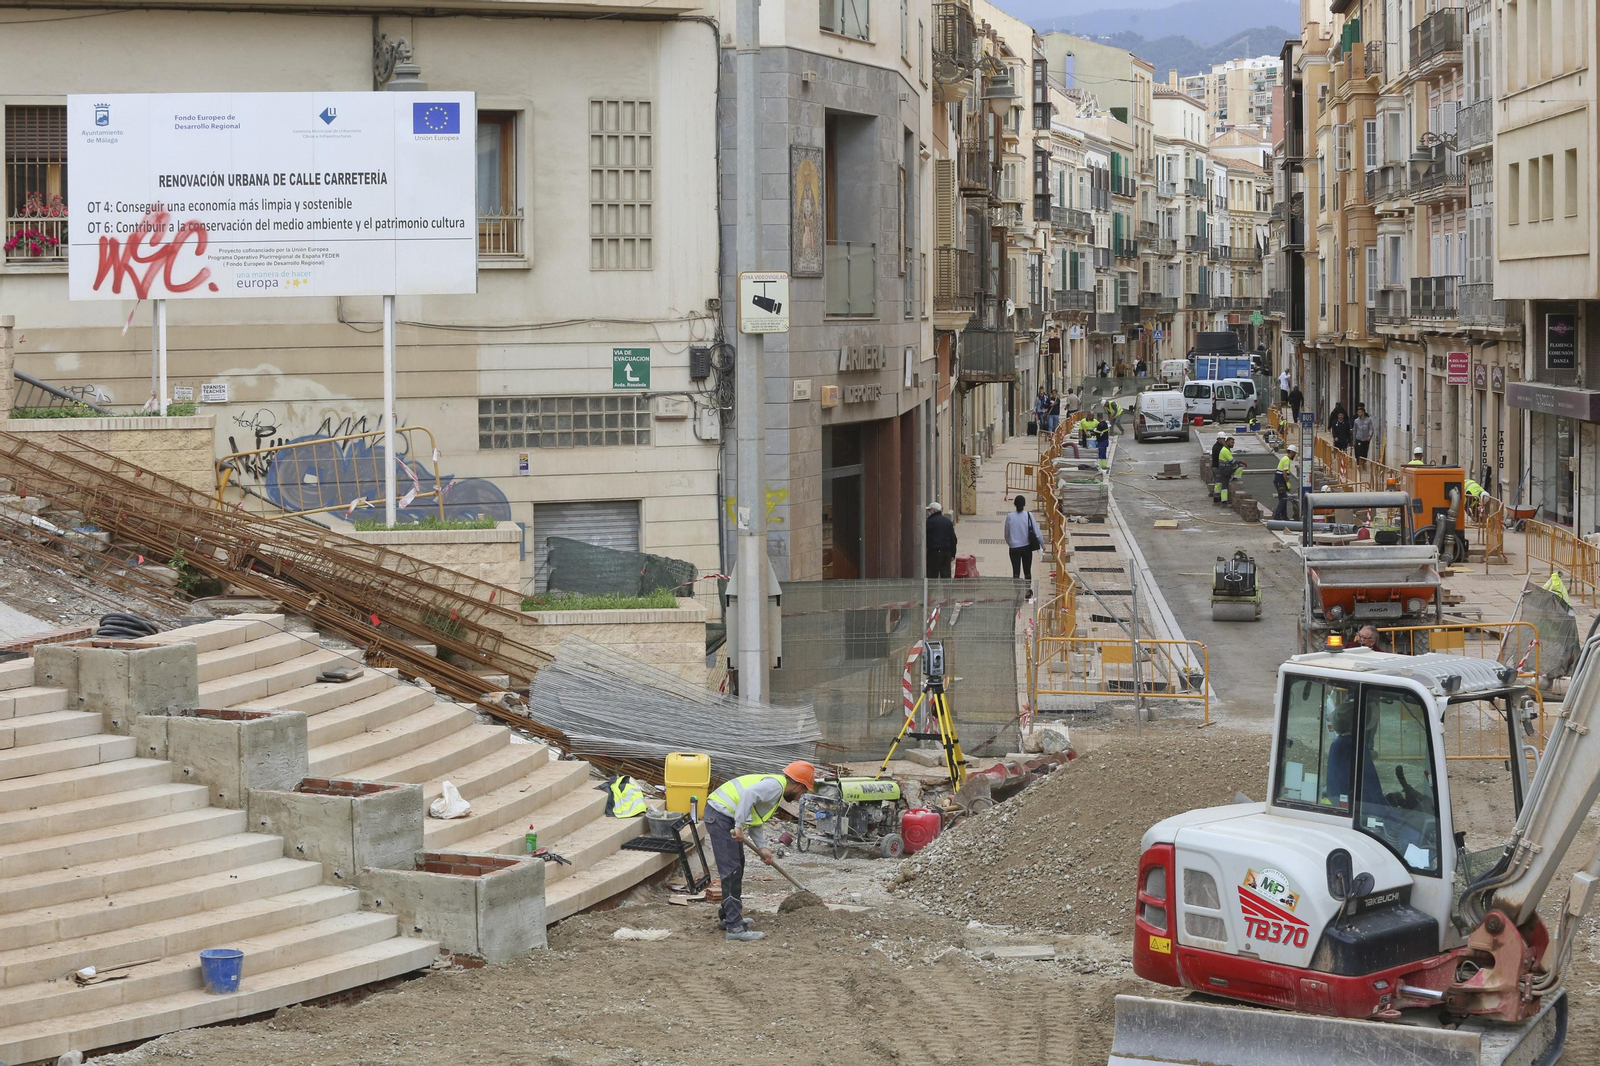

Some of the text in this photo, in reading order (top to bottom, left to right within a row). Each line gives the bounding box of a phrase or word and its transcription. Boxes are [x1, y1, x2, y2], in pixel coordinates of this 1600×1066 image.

[159, 169, 387, 187] RENOVACIÓN URBANA DE CALLE CARRETERÍA
[88, 198, 352, 215] OT 4: Conseguir una economía más limpia y sostenible
[88, 222, 101, 233] OT
[104, 221, 113, 233] 6:
[116, 220, 166, 233] Contribuir
[178, 220, 185, 232] la
[189, 219, 252, 231] conservación
[256, 219, 270, 230] del
[273, 218, 304, 230] medio
[306, 218, 352, 230] ambiente
[356, 220, 361, 232] y
[364, 217, 372, 229] el
[375, 217, 428, 231] patrimonio
[431, 217, 465, 228] cultura
[237, 279, 279, 289] europa
[1244, 916, 1310, 949] TB370
